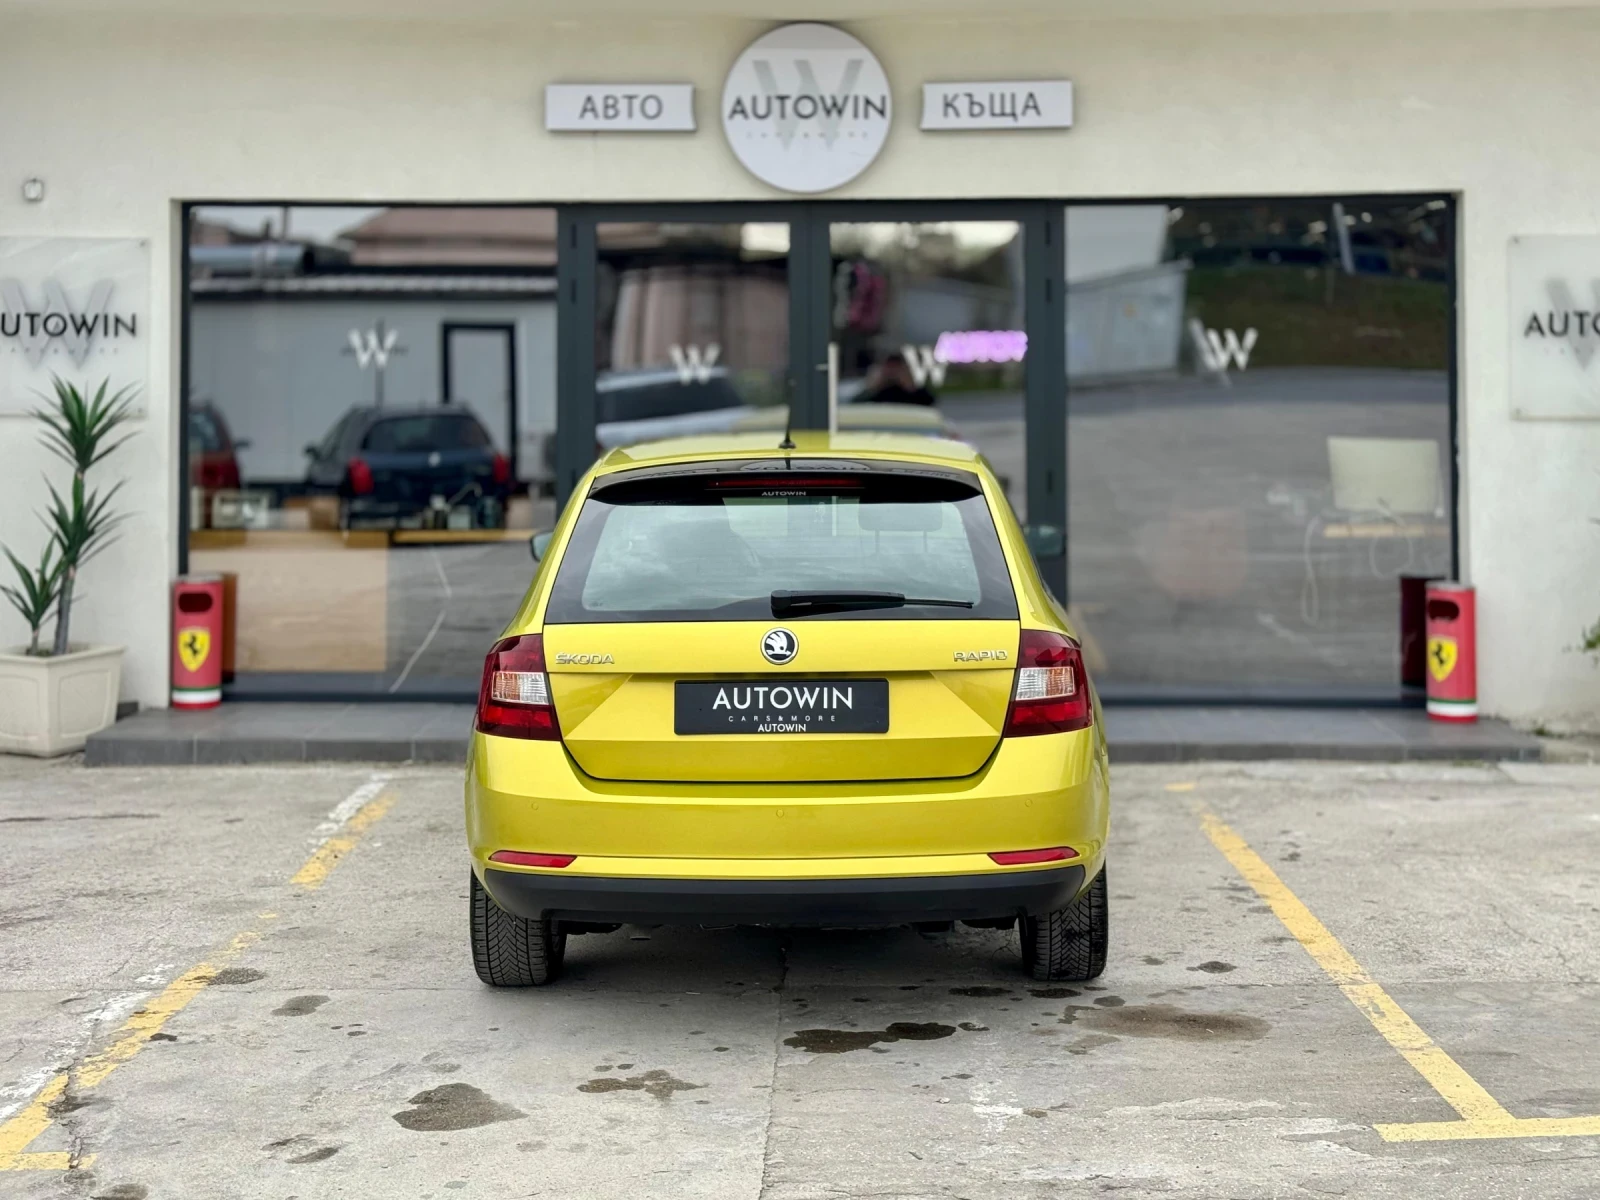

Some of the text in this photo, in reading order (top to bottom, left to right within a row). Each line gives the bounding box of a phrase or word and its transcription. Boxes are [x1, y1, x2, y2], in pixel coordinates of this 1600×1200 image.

[578, 93, 664, 121] АВТО
[728, 94, 887, 120] AUTOWIN
[942, 91, 1042, 122] КЪЩА
[953, 649, 1008, 662] RAPID
[712, 686, 854, 710] AUTOWIN
[757, 723, 807, 733] AUTOWIN
